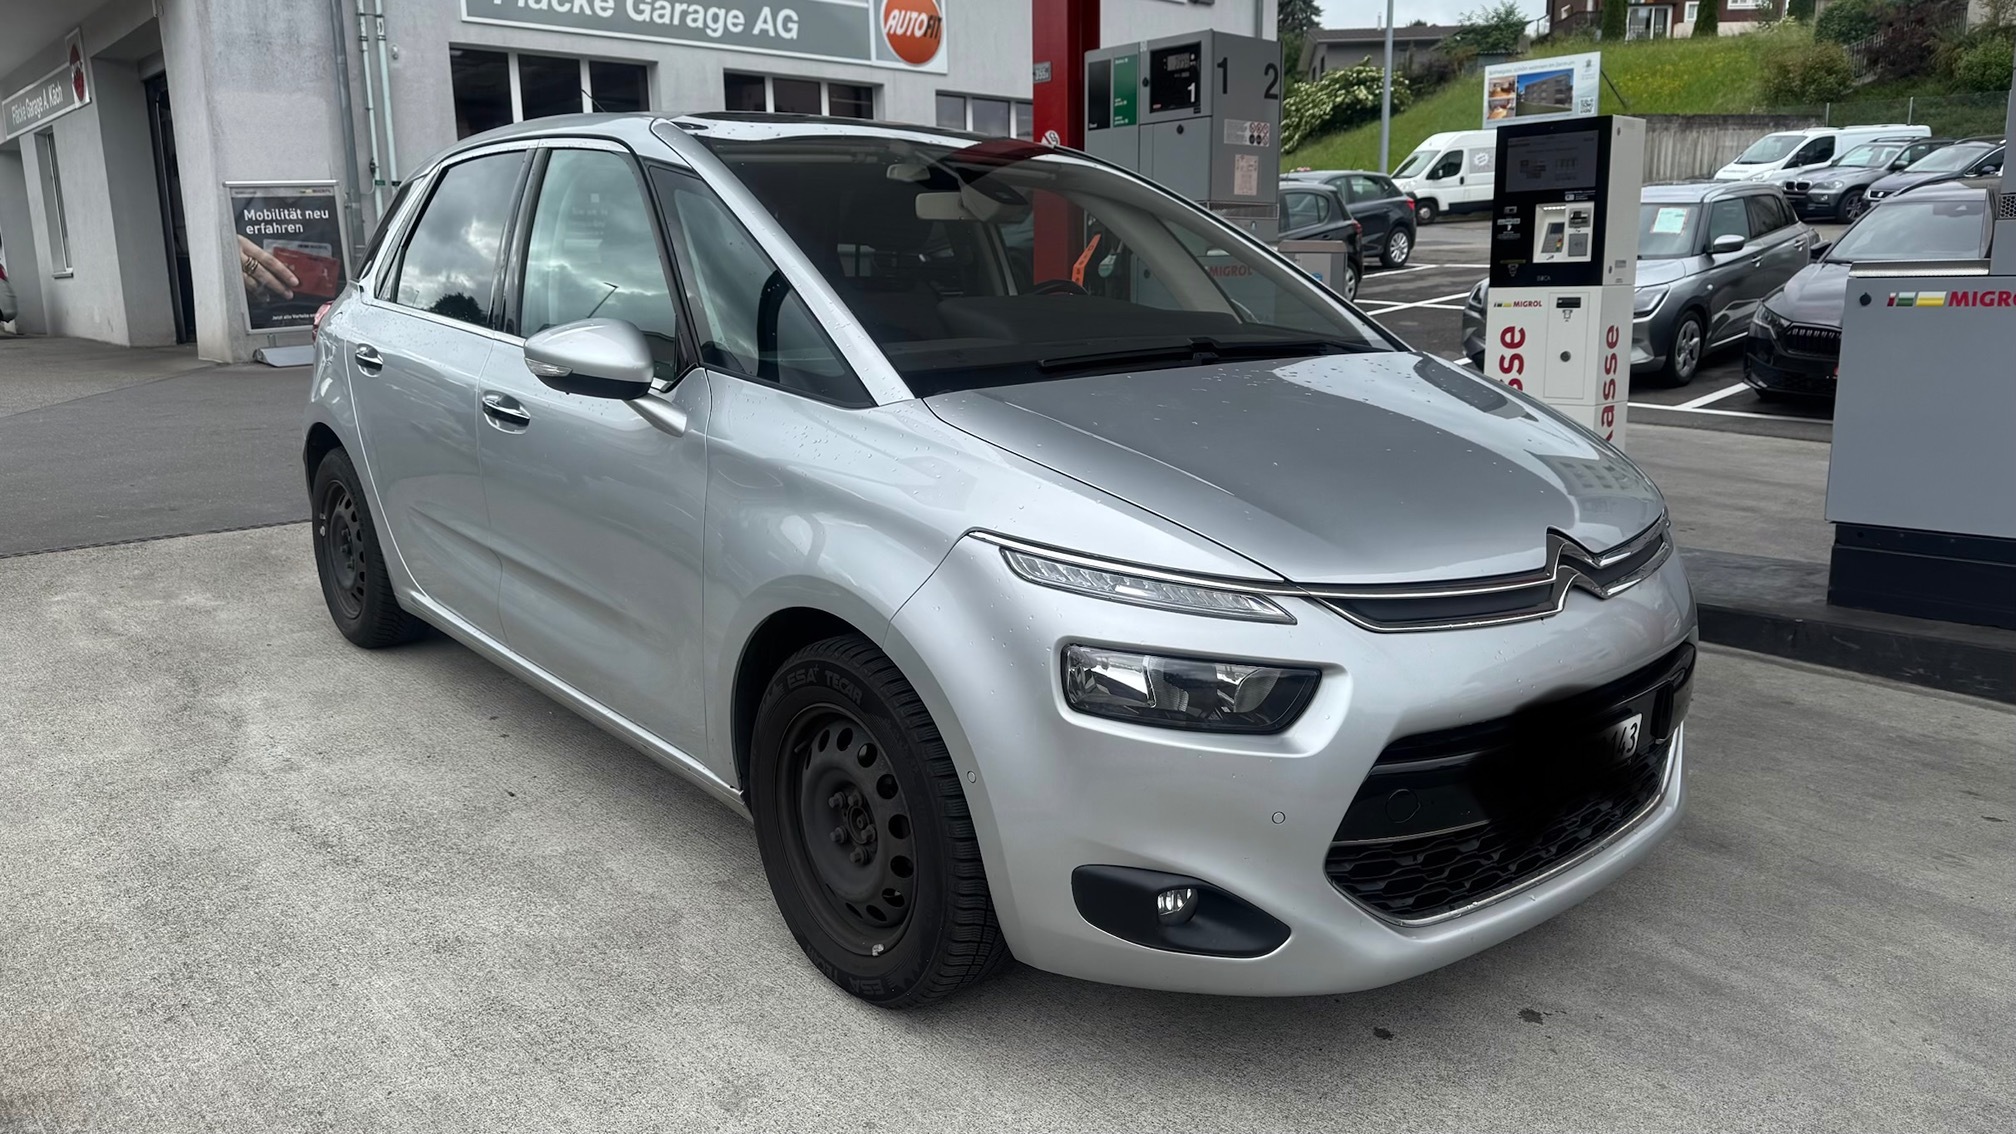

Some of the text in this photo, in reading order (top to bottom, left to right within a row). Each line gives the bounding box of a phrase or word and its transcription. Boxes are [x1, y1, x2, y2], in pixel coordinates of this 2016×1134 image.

[626, 0, 745, 38] Garage
[752, 6, 799, 39] AG
[884, 9, 942, 39] AUTOFIT
[1217, 57, 1228, 94] 1
[1264, 62, 1279, 100] 2
[1187, 82, 1196, 102] 1
[26, 97, 43, 118] Garage
[243, 208, 329, 221] Mobilität neu
[246, 222, 304, 234] erfahren
[1513, 300, 1543, 308] MIGROL
[824, 669, 863, 706] TECAR
